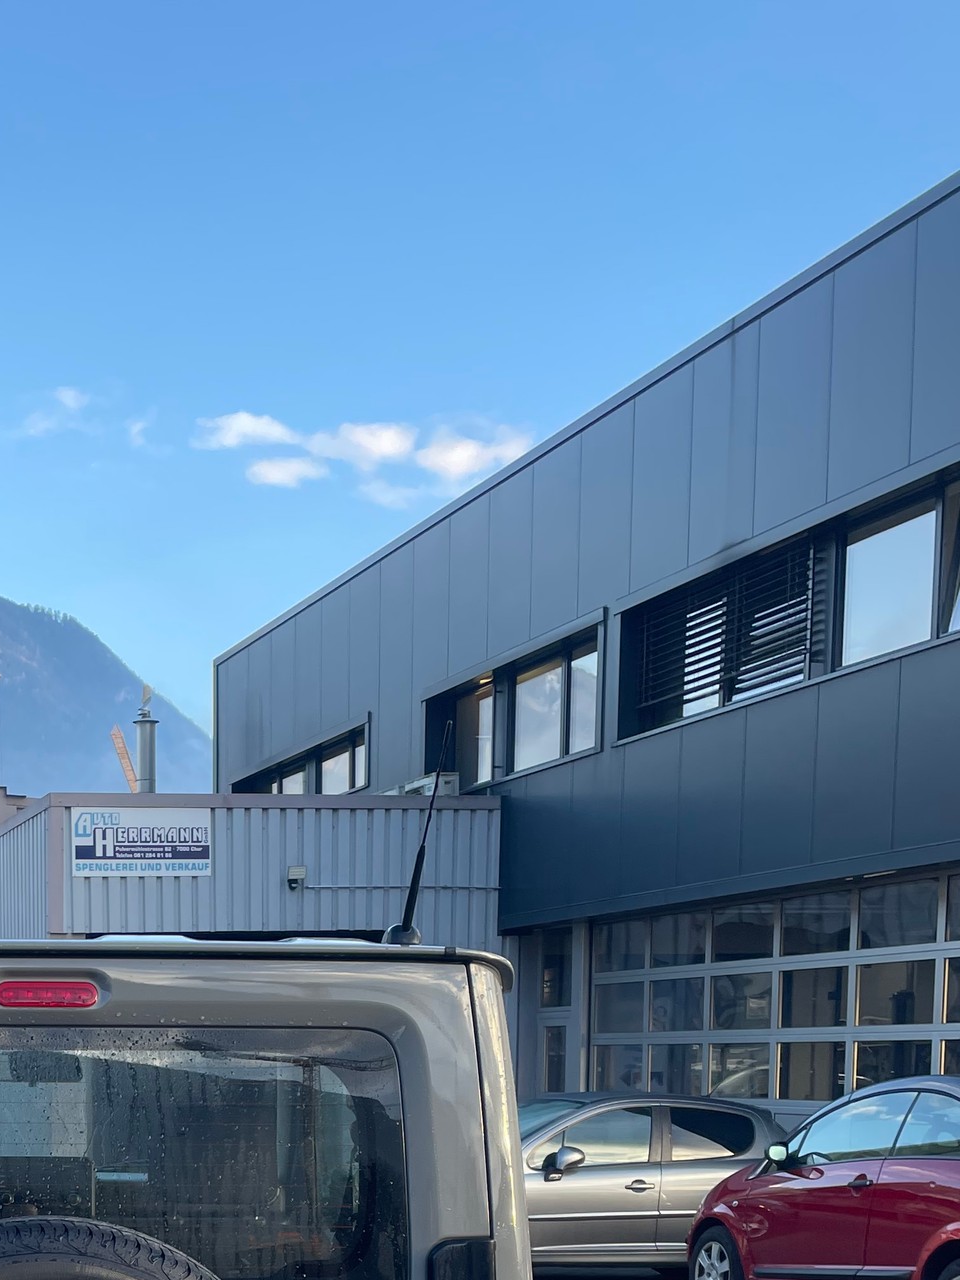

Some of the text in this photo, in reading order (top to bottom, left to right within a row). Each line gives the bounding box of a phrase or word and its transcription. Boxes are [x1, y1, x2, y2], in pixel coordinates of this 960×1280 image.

[93, 827, 203, 857] HERRMANN
[75, 862, 210, 872] SPENGLEREI UND VERKAUF
